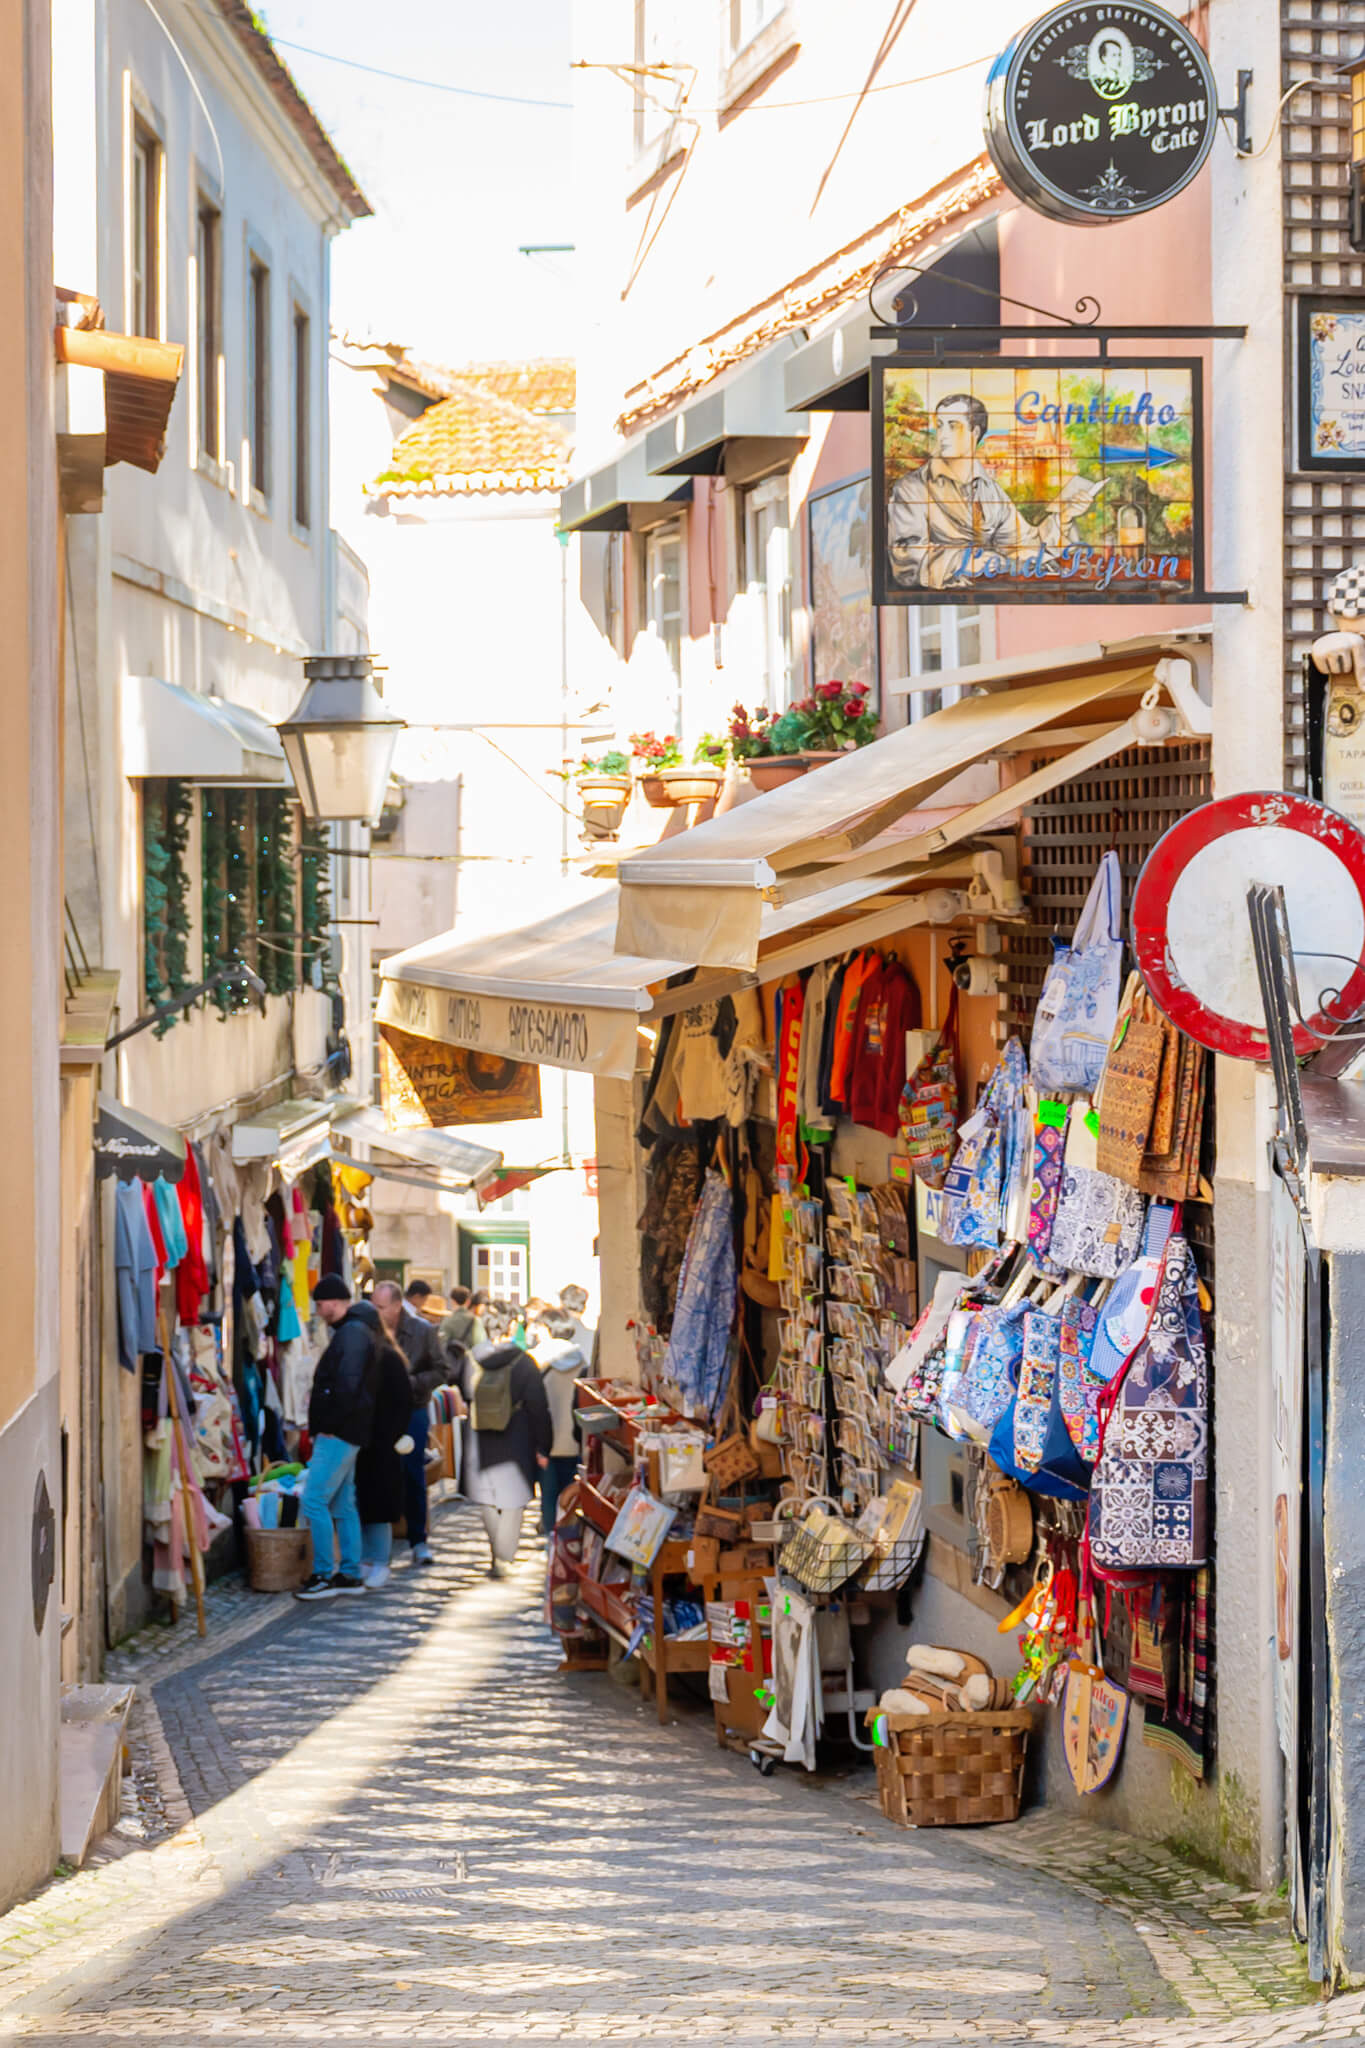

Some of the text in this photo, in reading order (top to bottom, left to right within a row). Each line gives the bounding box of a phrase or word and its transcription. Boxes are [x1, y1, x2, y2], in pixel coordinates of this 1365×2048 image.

[1170, 39, 1197, 78] Eden
[1024, 99, 1206, 152] Lord Byron
[1015, 391, 1180, 425] Cantinho
[953, 541, 1179, 590] Lord Byron
[509, 1005, 589, 1062] ARTESANATO
